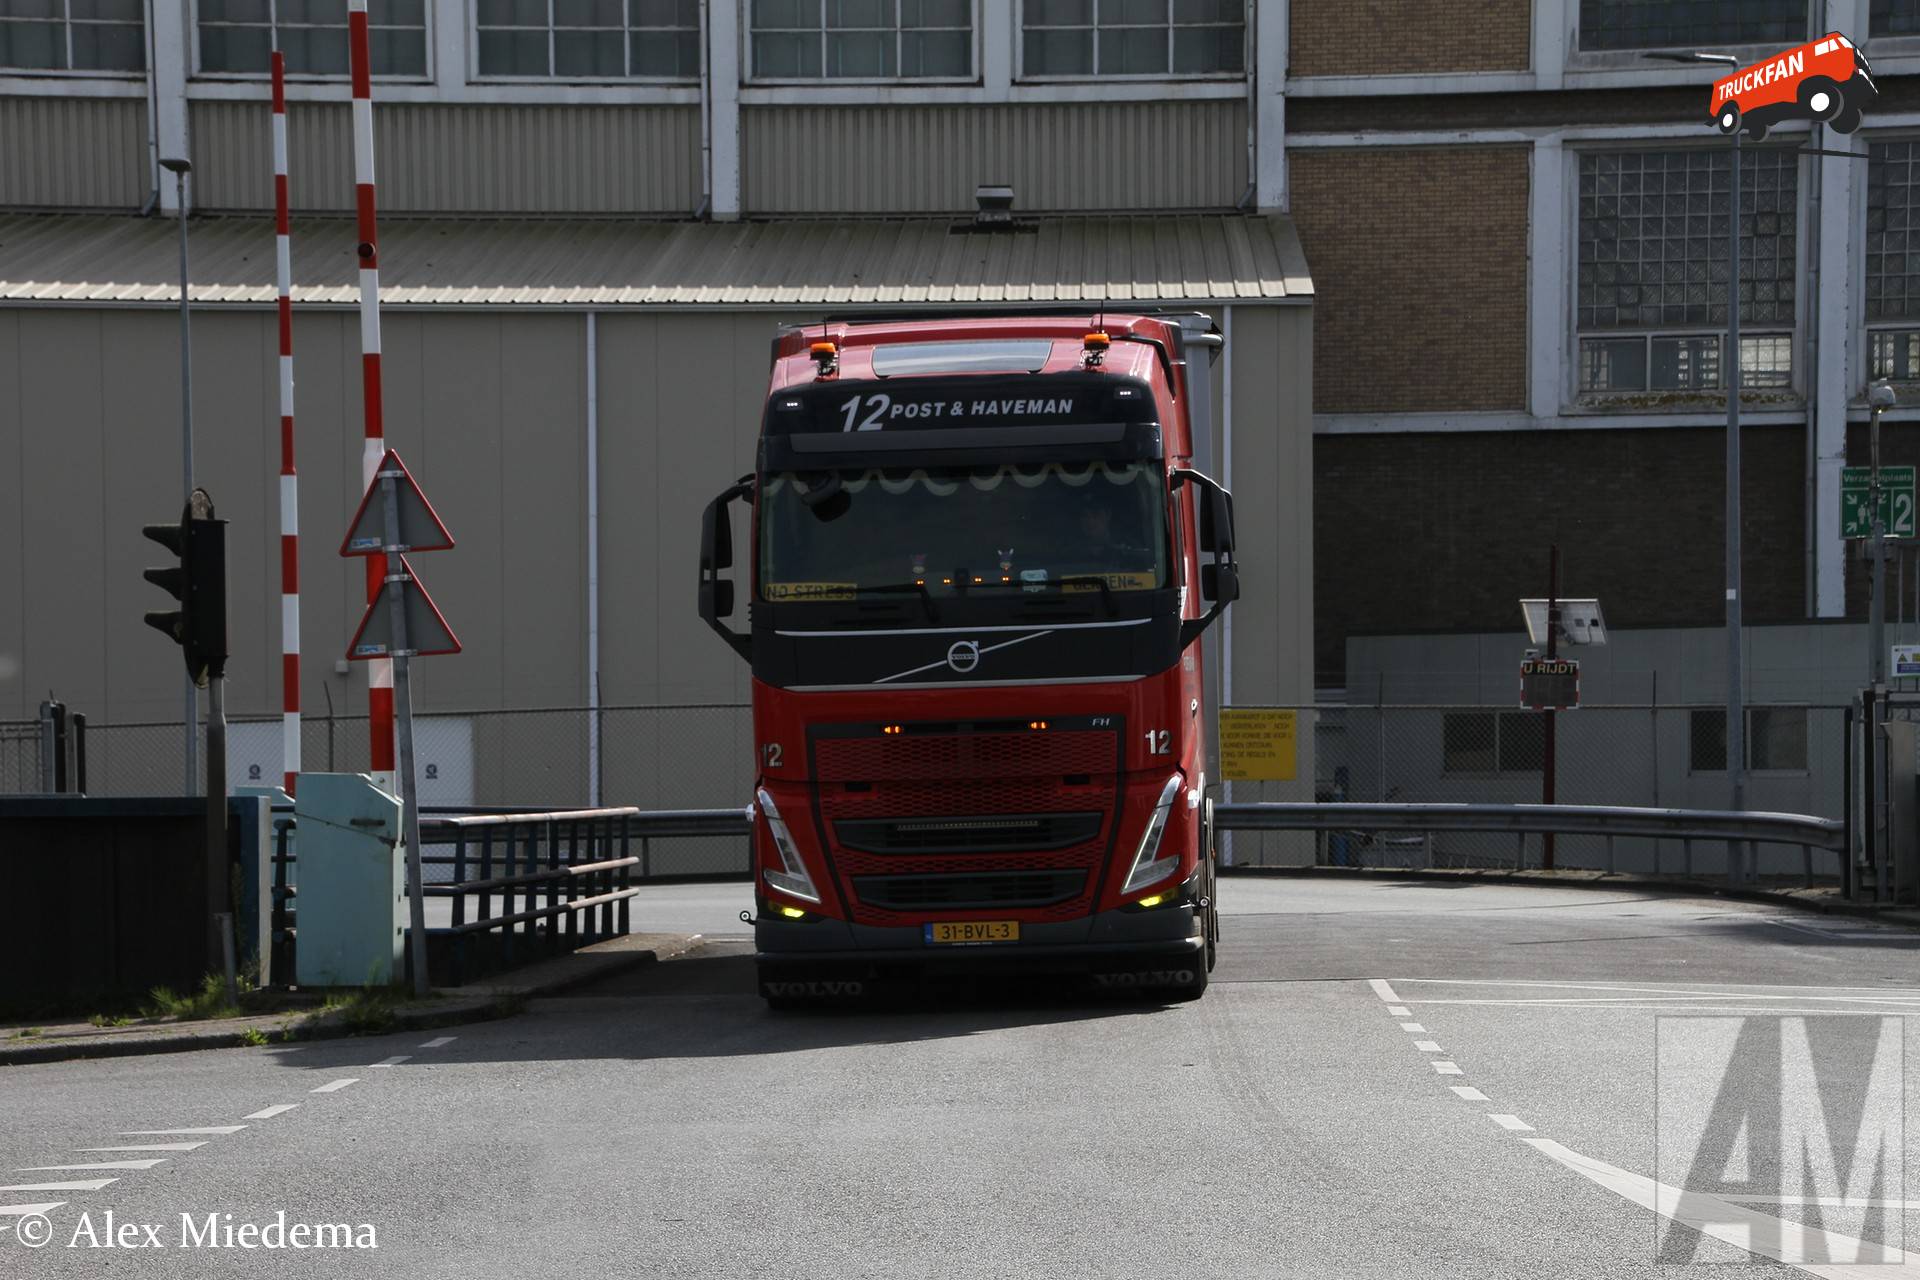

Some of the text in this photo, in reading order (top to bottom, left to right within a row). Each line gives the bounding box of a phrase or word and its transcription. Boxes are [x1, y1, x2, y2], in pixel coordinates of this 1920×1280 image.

[840, 393, 1074, 433] 12 POST & HAVEMAN
[1843, 474, 1913, 483] Verzalplaats
[1894, 493, 1912, 532] 2
[1523, 663, 1576, 674] U RIJDT
[1092, 717, 1111, 727] FH
[1144, 729, 1171, 755] 12
[761, 742, 783, 767] 12
[942, 923, 1010, 940] 31-BVL-3
[1093, 969, 1194, 985] VOLVO
[764, 981, 863, 996] VOLVO
